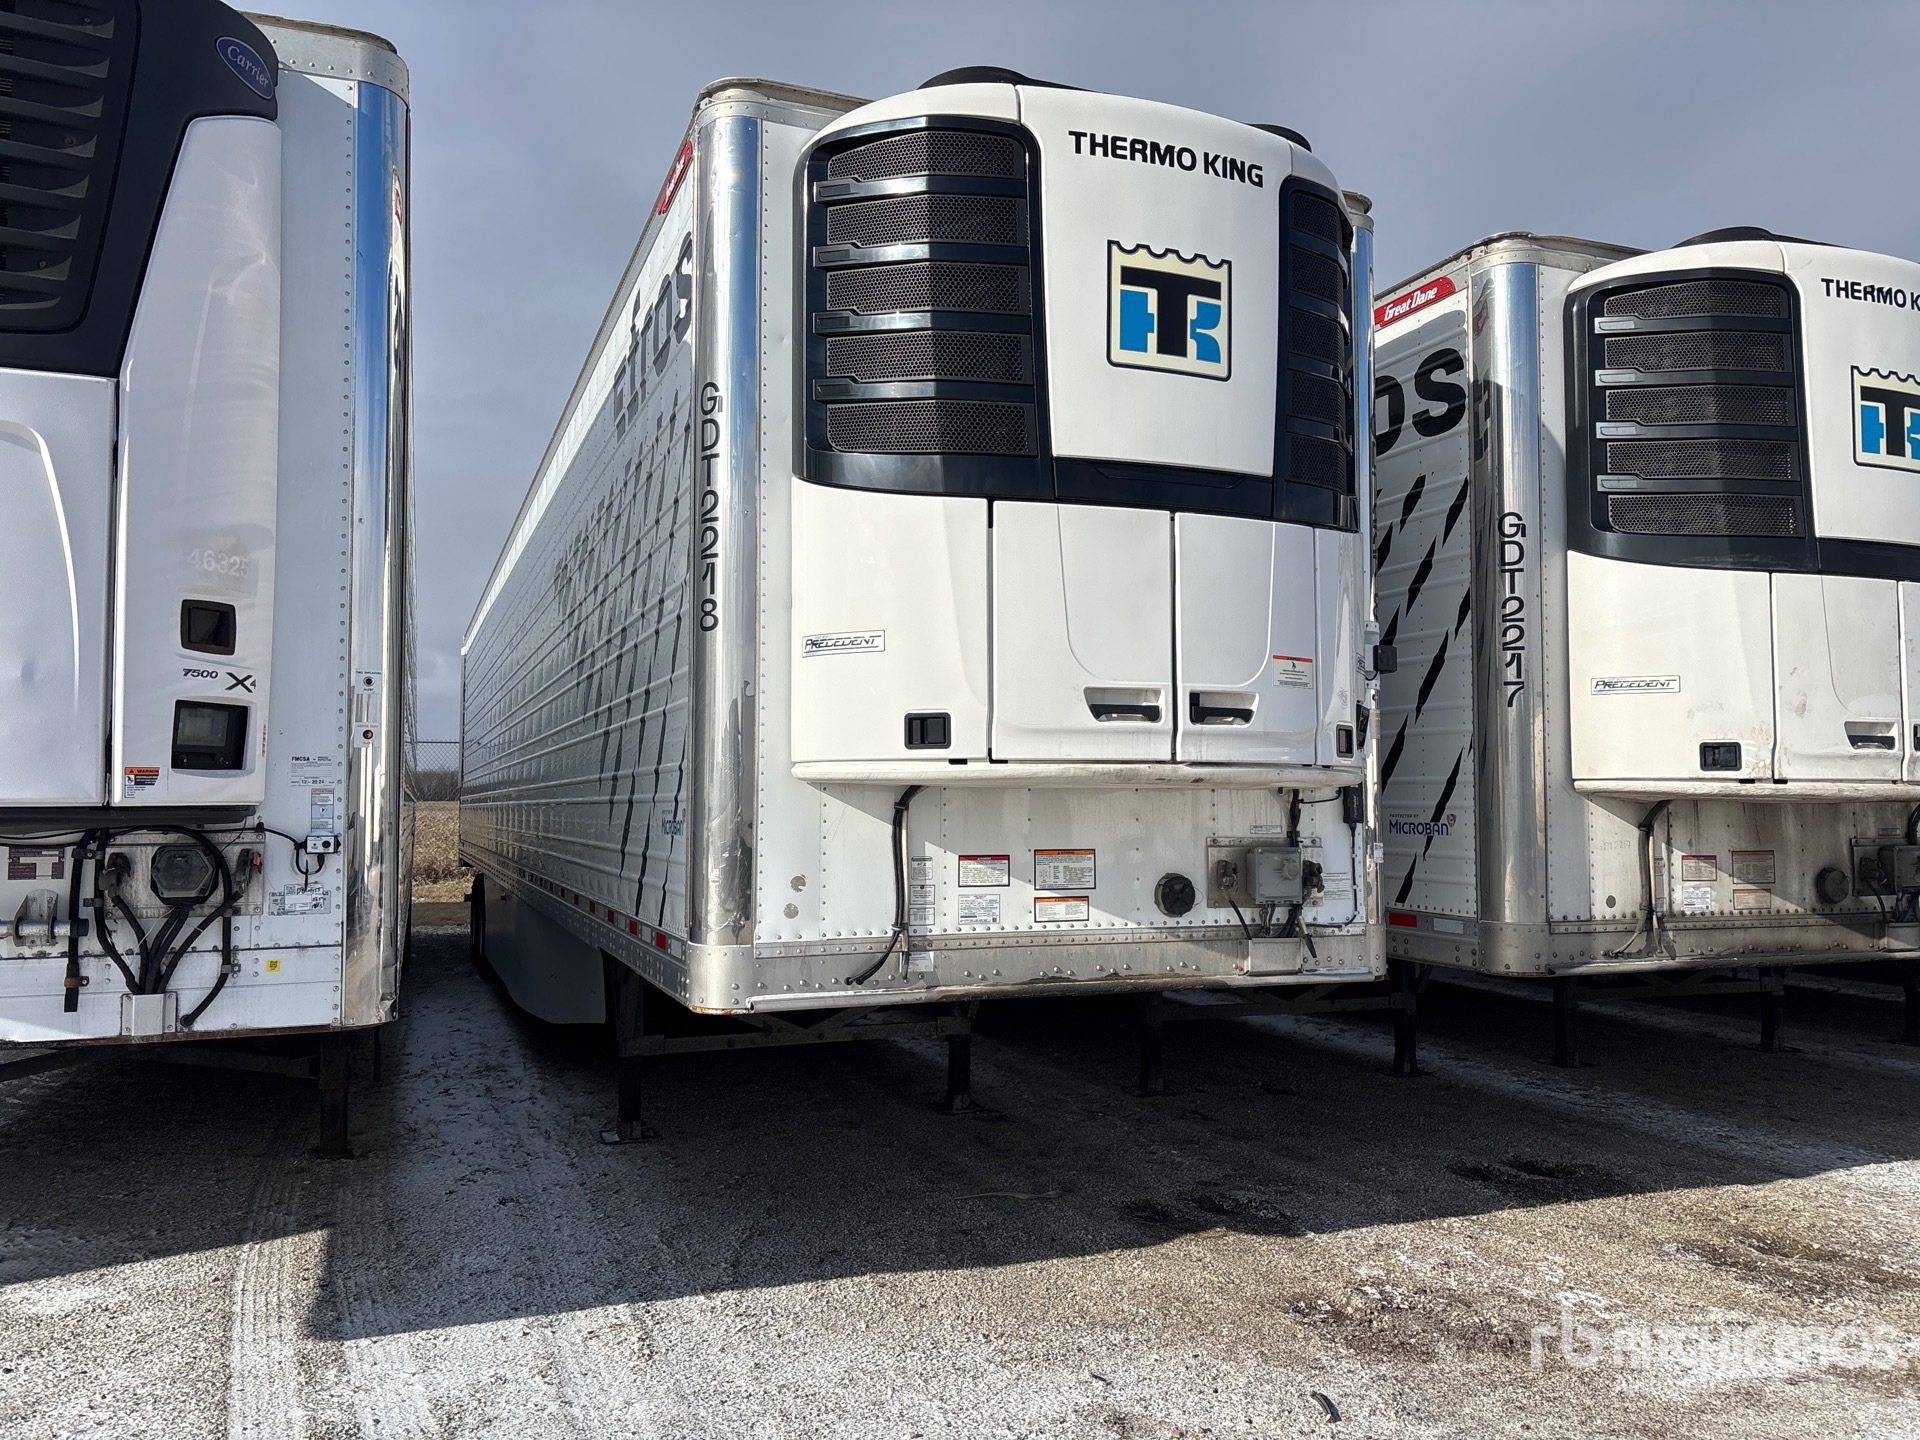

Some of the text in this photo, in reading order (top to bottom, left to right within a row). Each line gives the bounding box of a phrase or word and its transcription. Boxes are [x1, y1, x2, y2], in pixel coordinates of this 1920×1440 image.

[227, 45, 269, 88] Carrier
[1068, 130, 1264, 188] THERMO KING
[1384, 287, 1438, 321] Great Dane
[1820, 278, 1907, 309] THERMO
[700, 381, 724, 632] GDT2218
[1497, 512, 1527, 708] GDT2217
[182, 668, 219, 680] 7500
